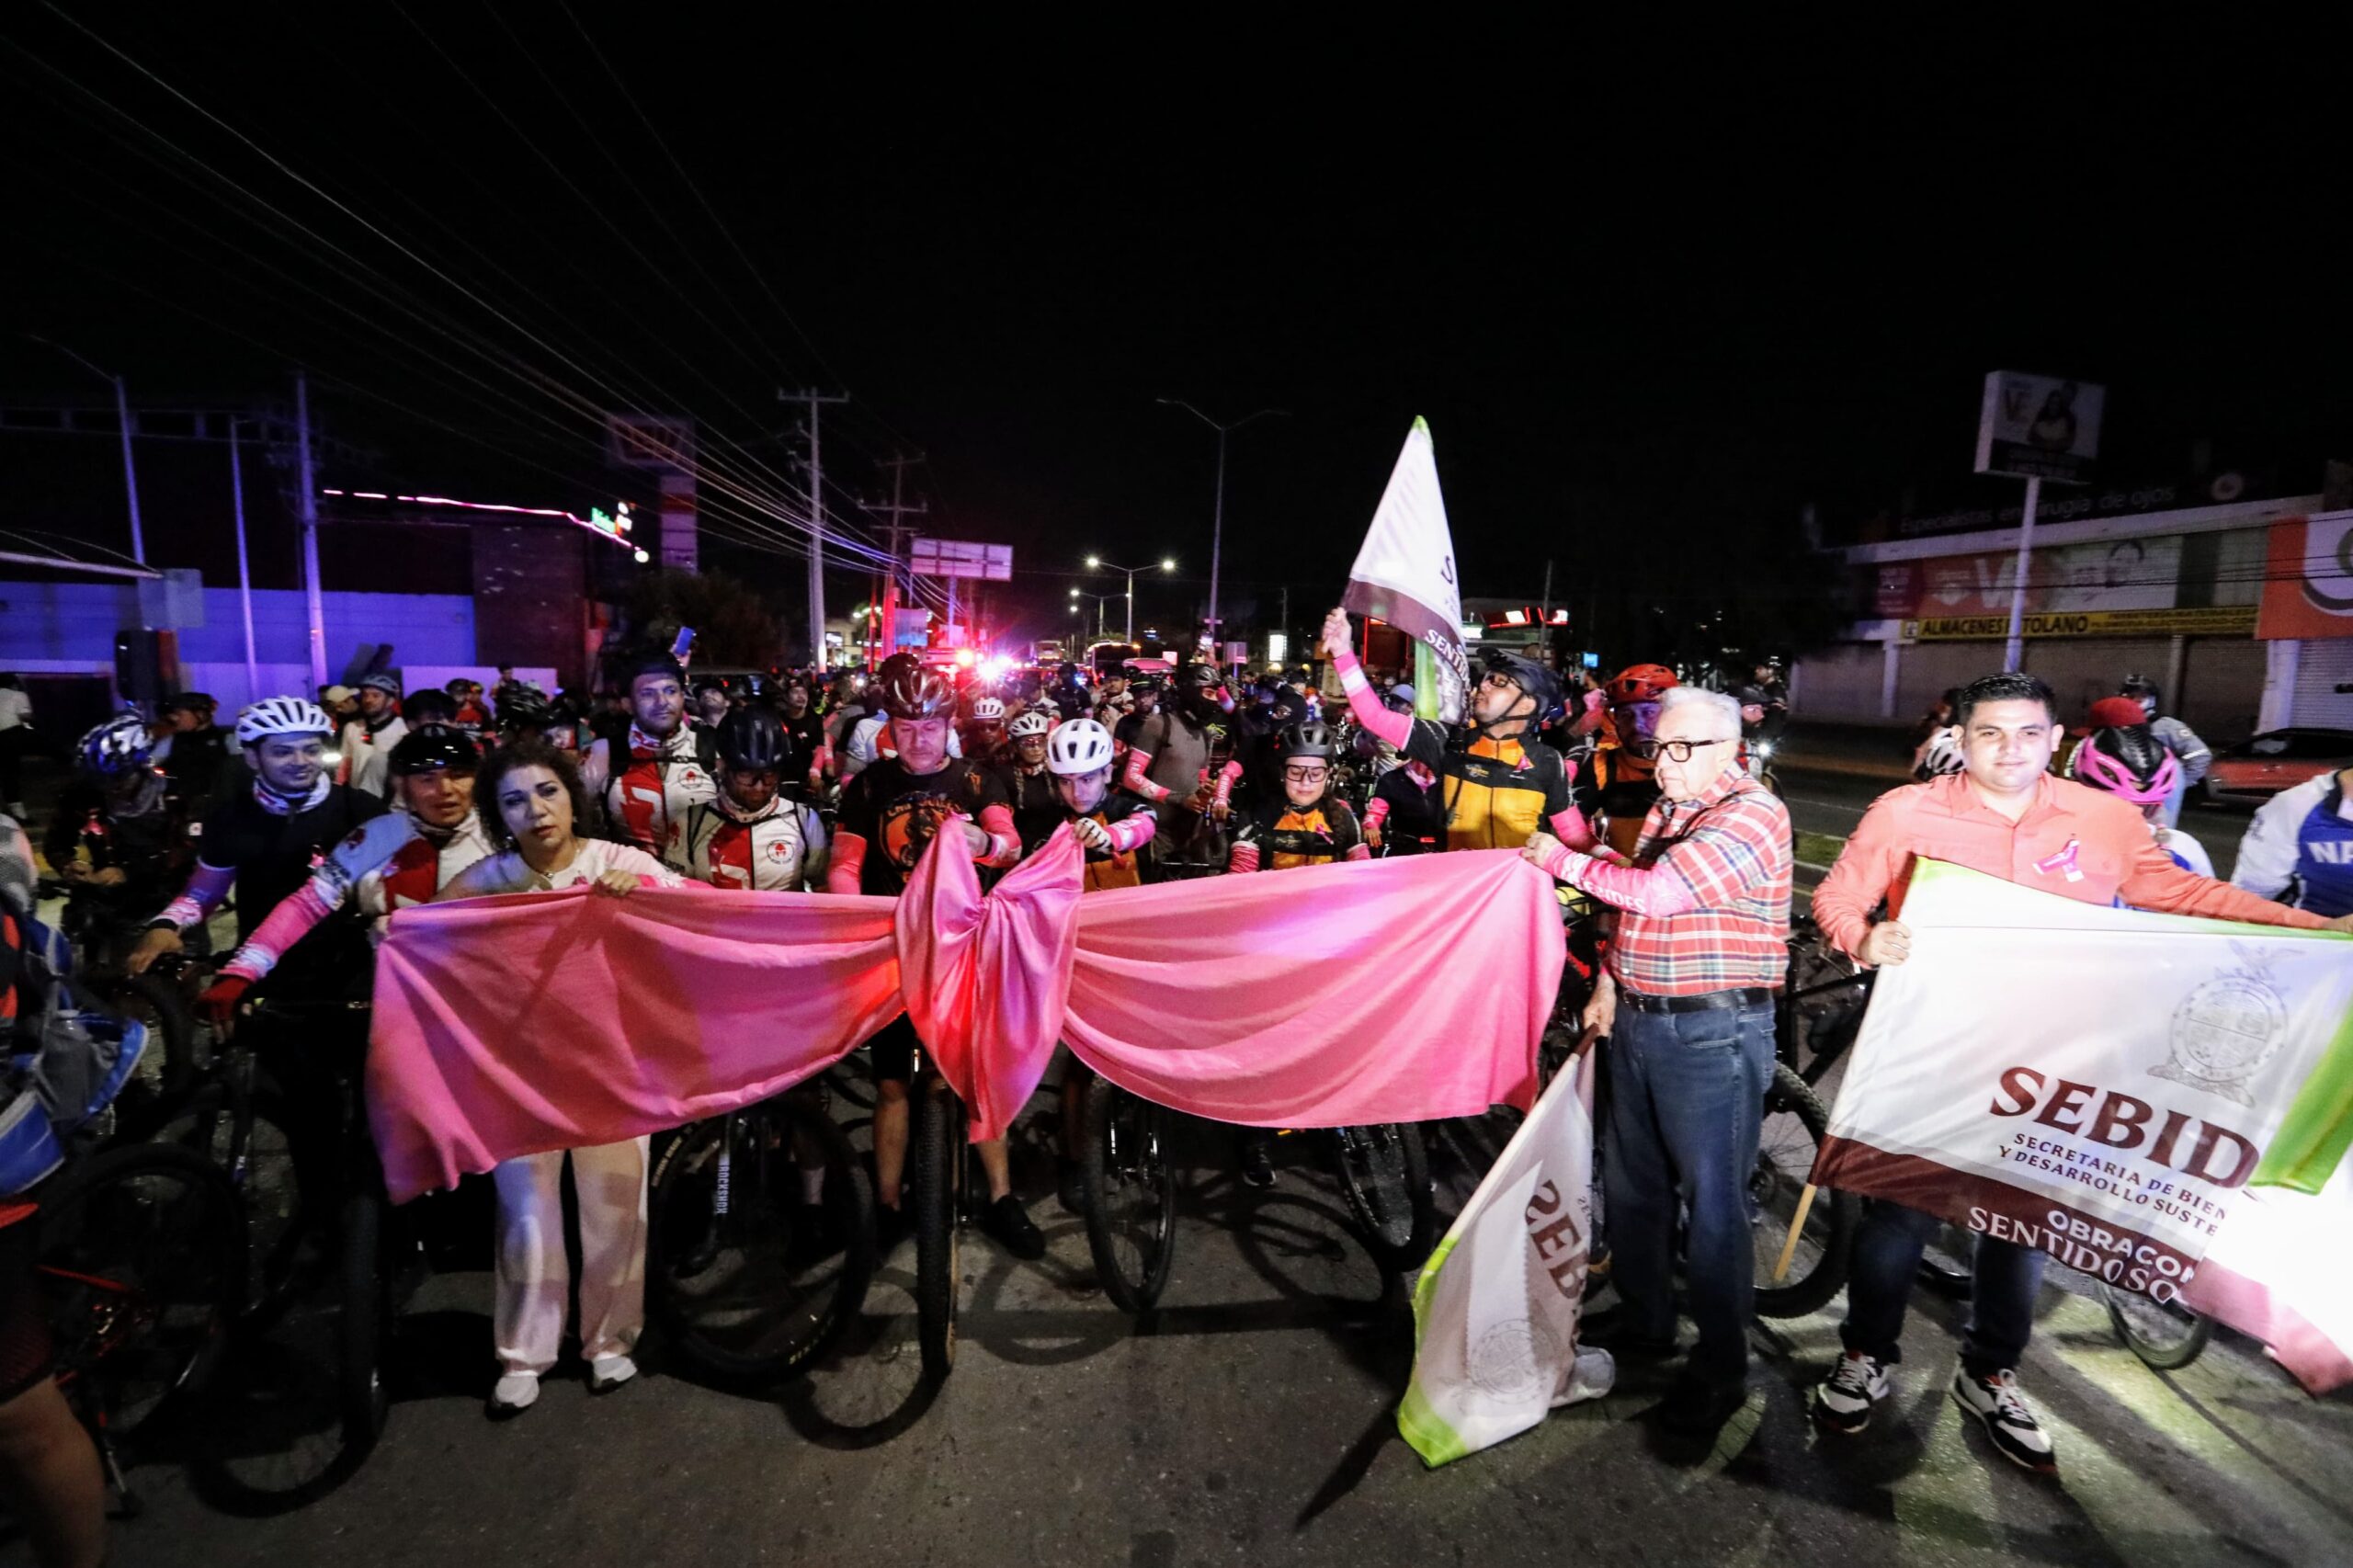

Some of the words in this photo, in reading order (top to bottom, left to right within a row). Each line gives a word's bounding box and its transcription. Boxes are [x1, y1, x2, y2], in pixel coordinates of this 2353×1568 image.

[1900, 506, 1993, 534] Especialistas
[2099, 489, 2123, 509] de
[2131, 484, 2176, 509] ojos
[1922, 619, 2002, 636] ALMACENES
[1990, 1066, 2260, 1188] SEBID
[1998, 1145, 2012, 1158] Y
[2015, 1151, 2148, 1205] DESARROLLO
[2154, 1199, 2218, 1237] SUSTE
[2014, 1133, 2140, 1186] SECRETARIA
[2147, 1179, 2174, 1195] DE
